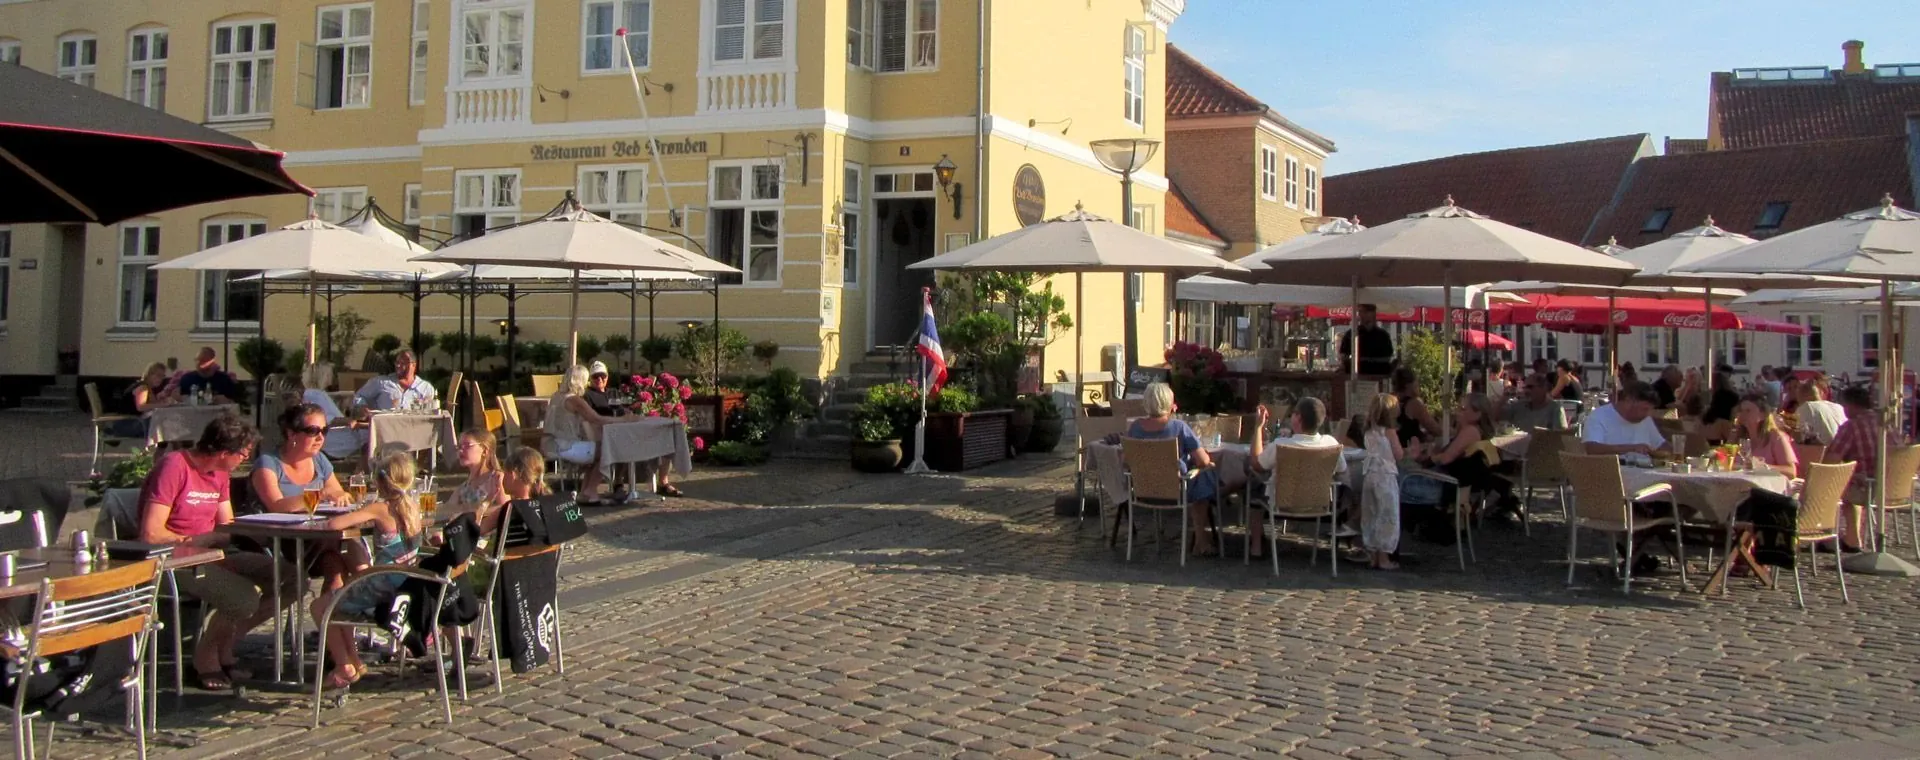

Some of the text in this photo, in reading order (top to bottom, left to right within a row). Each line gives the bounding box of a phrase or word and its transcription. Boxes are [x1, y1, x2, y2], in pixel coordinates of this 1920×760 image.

[531, 144, 606, 160] Restaurant
[612, 140, 641, 157] Ved
[518, 602, 526, 629] ROYAL
